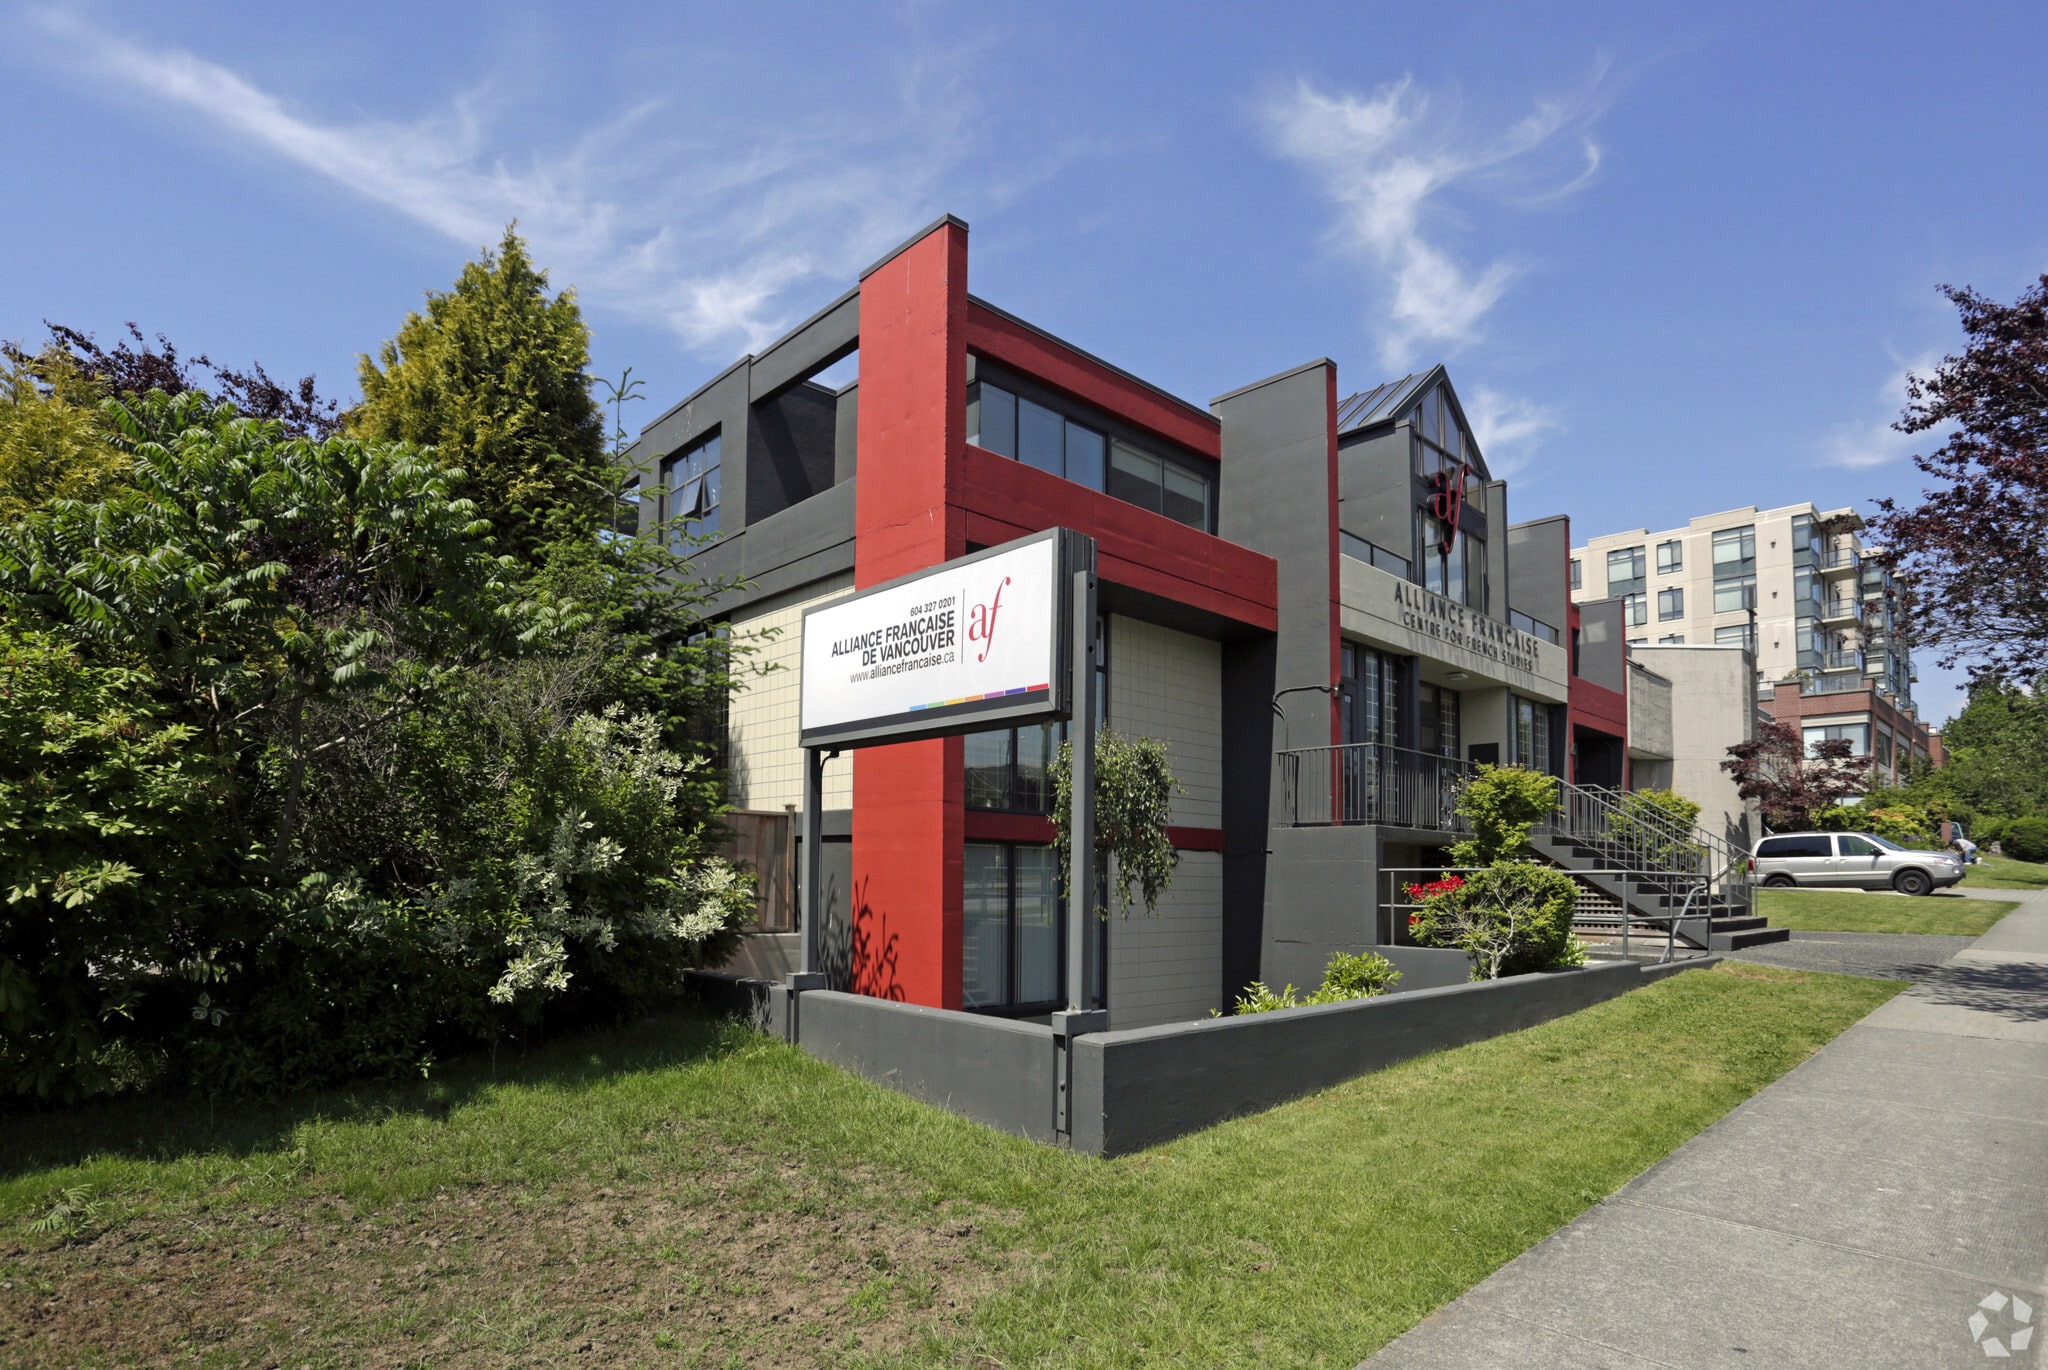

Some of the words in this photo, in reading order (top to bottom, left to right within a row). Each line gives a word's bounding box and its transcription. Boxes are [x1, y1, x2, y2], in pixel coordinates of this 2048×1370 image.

[910, 605, 923, 617] 604
[924, 600, 937, 613] 327
[938, 596, 955, 609] 0201
[968, 576, 1011, 663] af
[1394, 581, 1465, 628] ALLIANCE
[1471, 613, 1539, 658] FRANÇAISE
[831, 629, 883, 658] ALLIANCE
[885, 610, 955, 644] FRANÇAISE
[862, 648, 877, 667] DE
[880, 629, 955, 662] VANCOUVER
[1403, 611, 1441, 638] CENTRE
[1445, 627, 1463, 646] FOR
[1466, 635, 1498, 660] FRENCH
[1501, 651, 1533, 672] STUDIES
[850, 651, 955, 683] www.alliancefrancaise.ca
